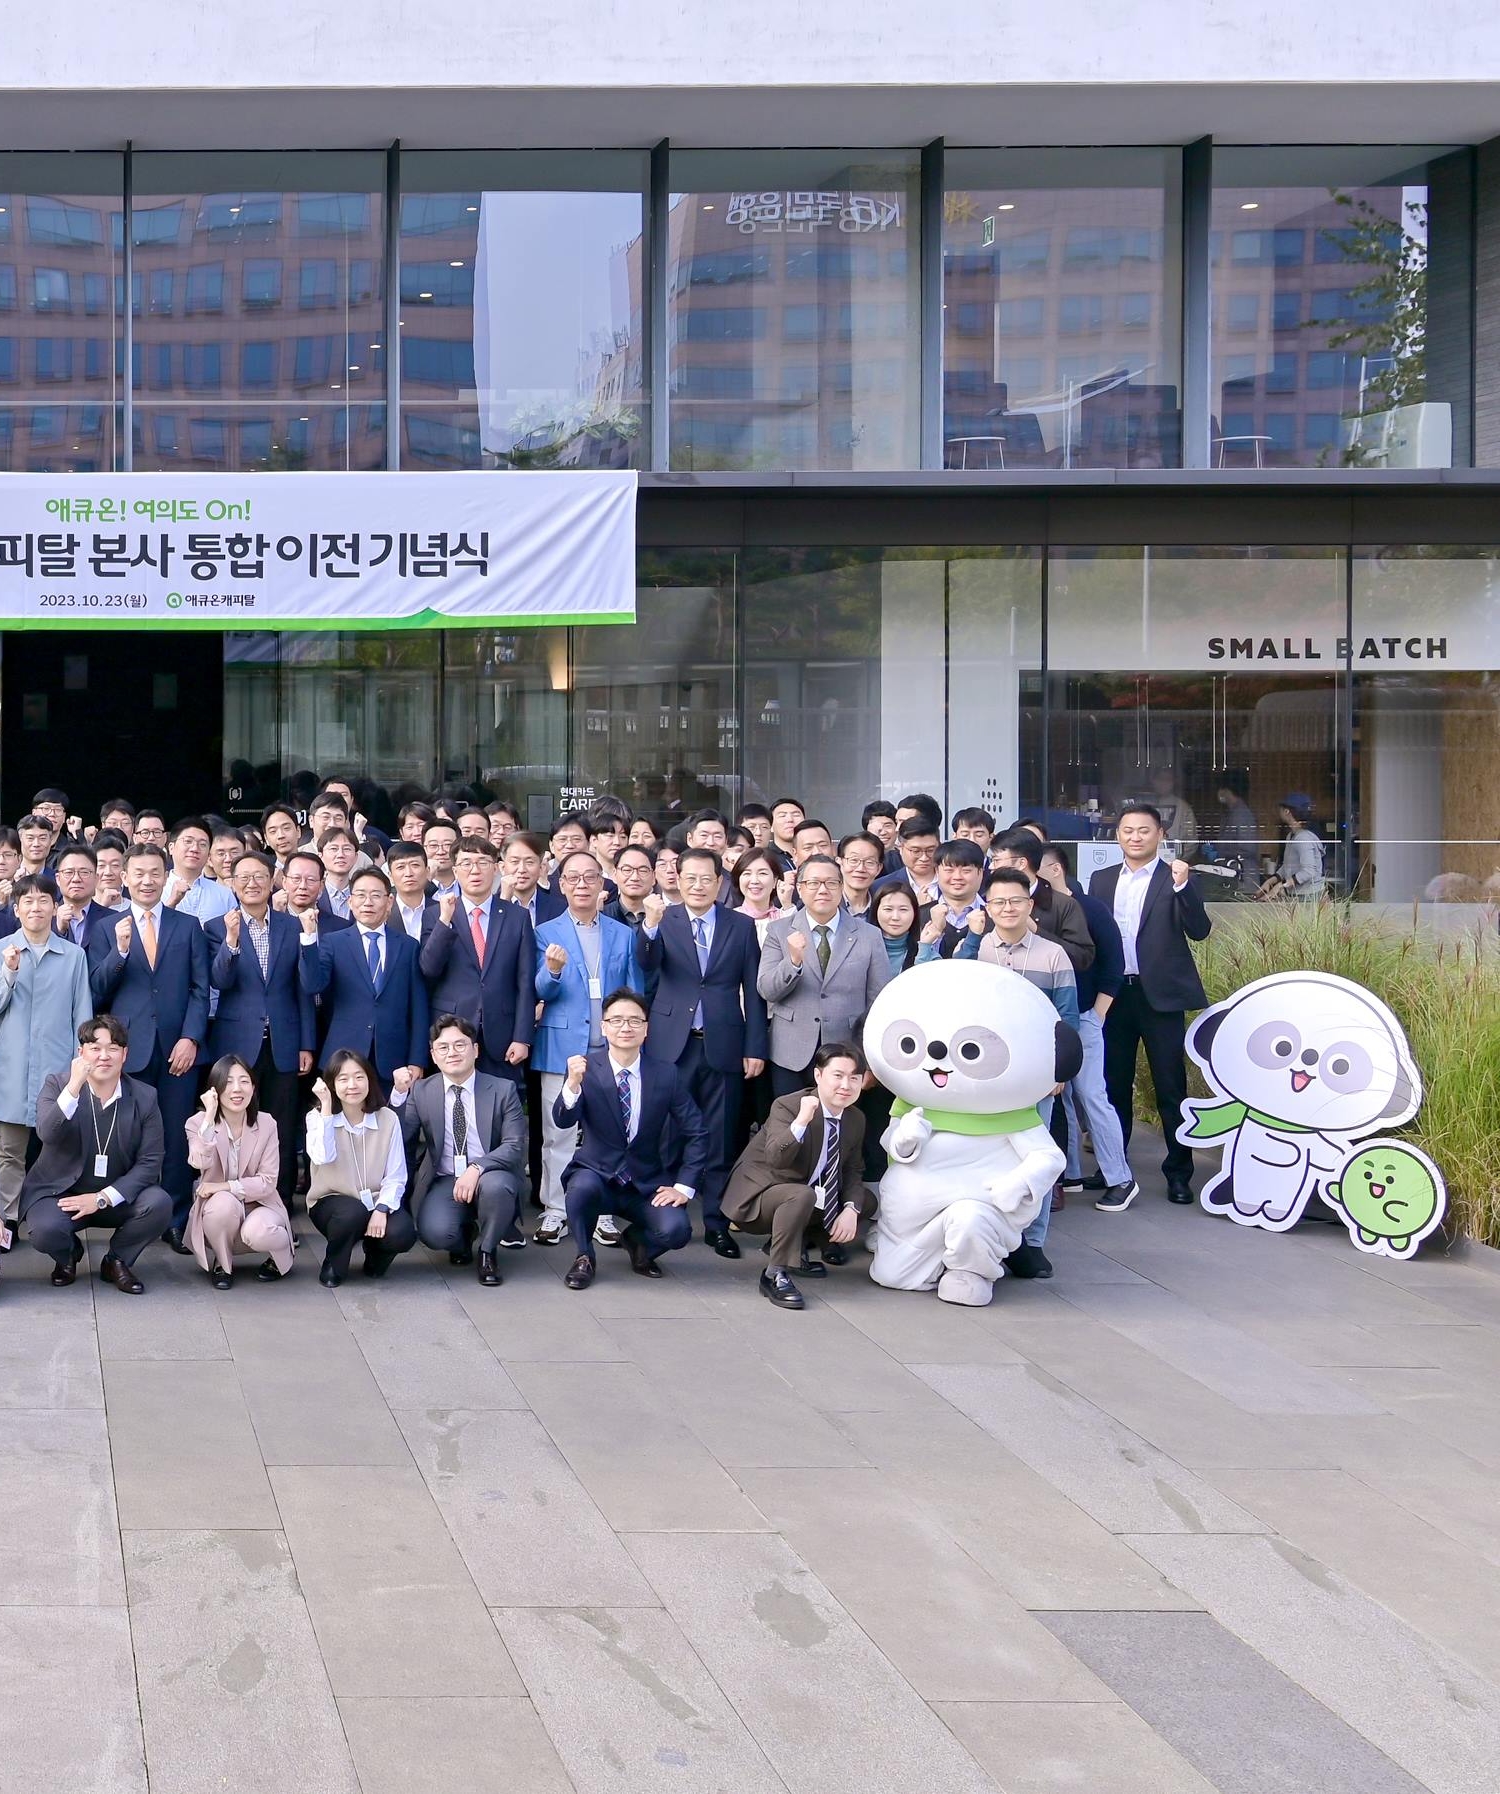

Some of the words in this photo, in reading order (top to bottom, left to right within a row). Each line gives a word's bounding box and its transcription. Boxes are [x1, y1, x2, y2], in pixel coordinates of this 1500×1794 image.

[45, 498, 126, 522] 애큐온!
[133, 499, 200, 523] 여의도
[205, 499, 251, 521] On!
[88, 533, 176, 579] 본사
[183, 533, 271, 581] 통합
[276, 533, 360, 579] 이전
[369, 532, 489, 578] 기념식
[39, 594, 148, 609] 2023.10.23(월)
[185, 594, 256, 607] 애큐온캐피탈
[1208, 637, 1321, 659] SMALL
[1336, 637, 1447, 659] BATCH
[560, 787, 595, 797] 현대카드
